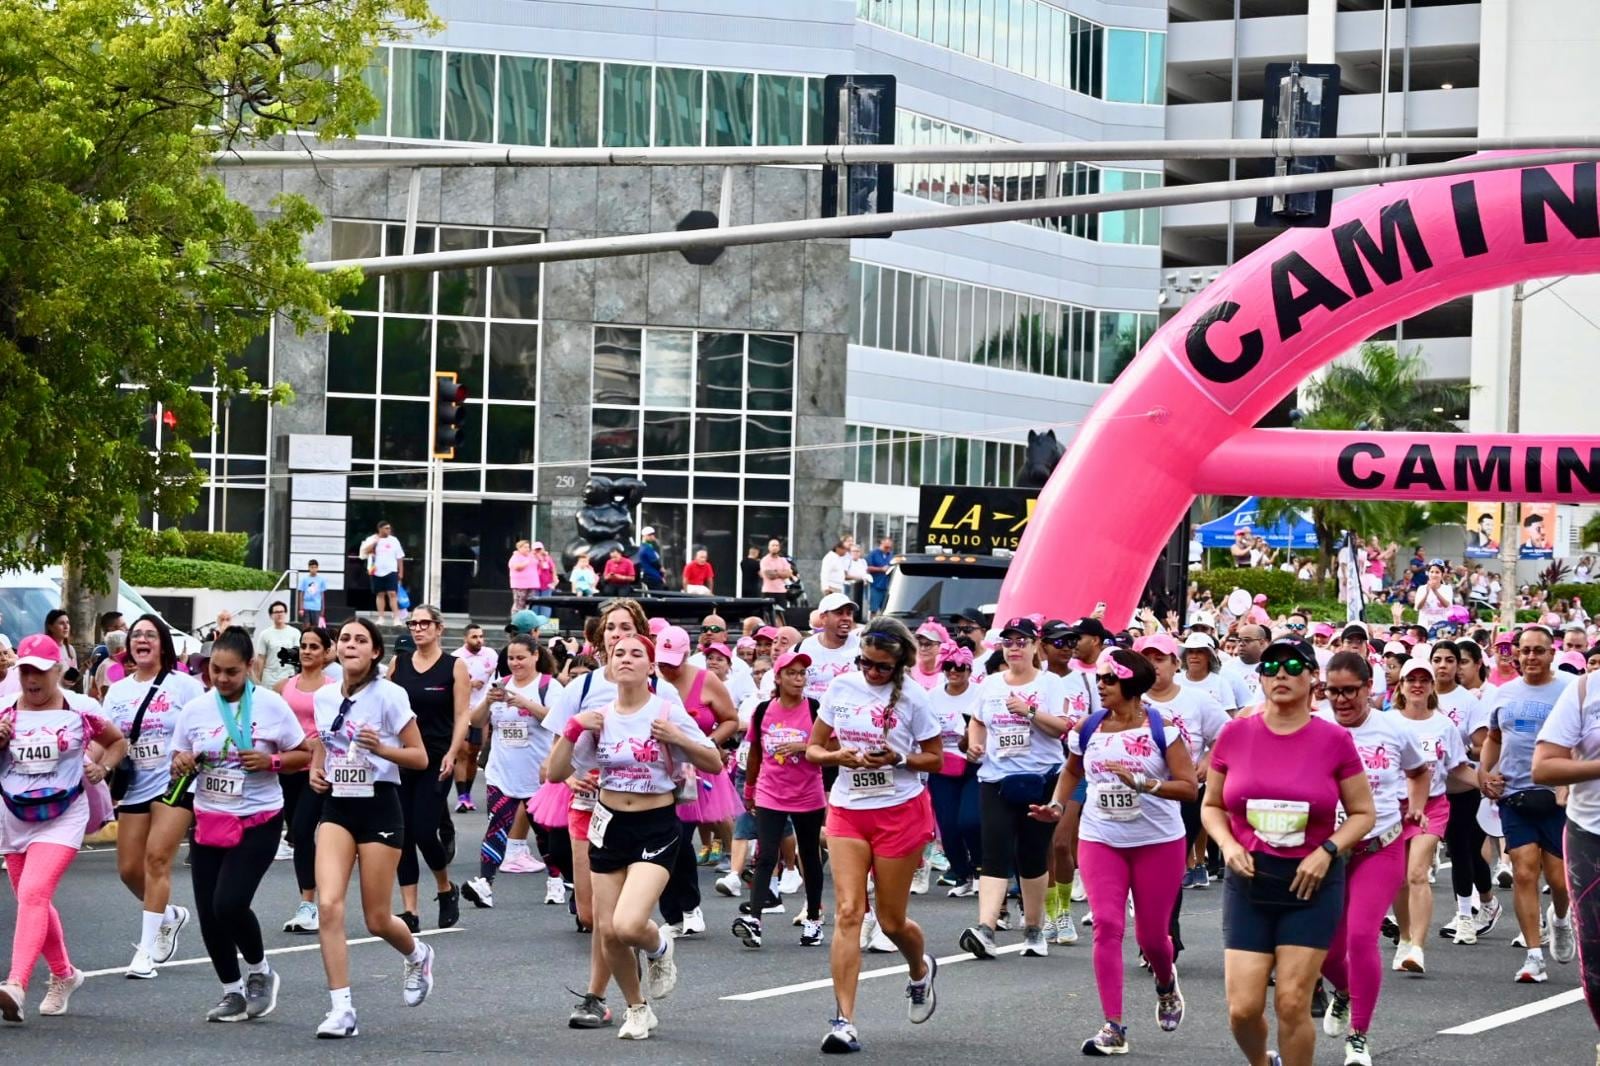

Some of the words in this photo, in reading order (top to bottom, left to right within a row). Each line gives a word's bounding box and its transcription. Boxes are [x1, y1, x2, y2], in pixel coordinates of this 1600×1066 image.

[1185, 162, 1600, 384] CAMIN
[1337, 442, 1600, 494] CAMIN
[555, 475, 575, 488] 250
[929, 495, 982, 530] LA
[928, 534, 981, 546] RADIO
[1000, 734, 1024, 747] 6930
[17, 745, 51, 760] 7440
[133, 744, 160, 759] 7614
[334, 768, 366, 782] 8020
[853, 771, 886, 788] 9538
[206, 776, 235, 794] 8021
[1100, 793, 1133, 808] 9133
